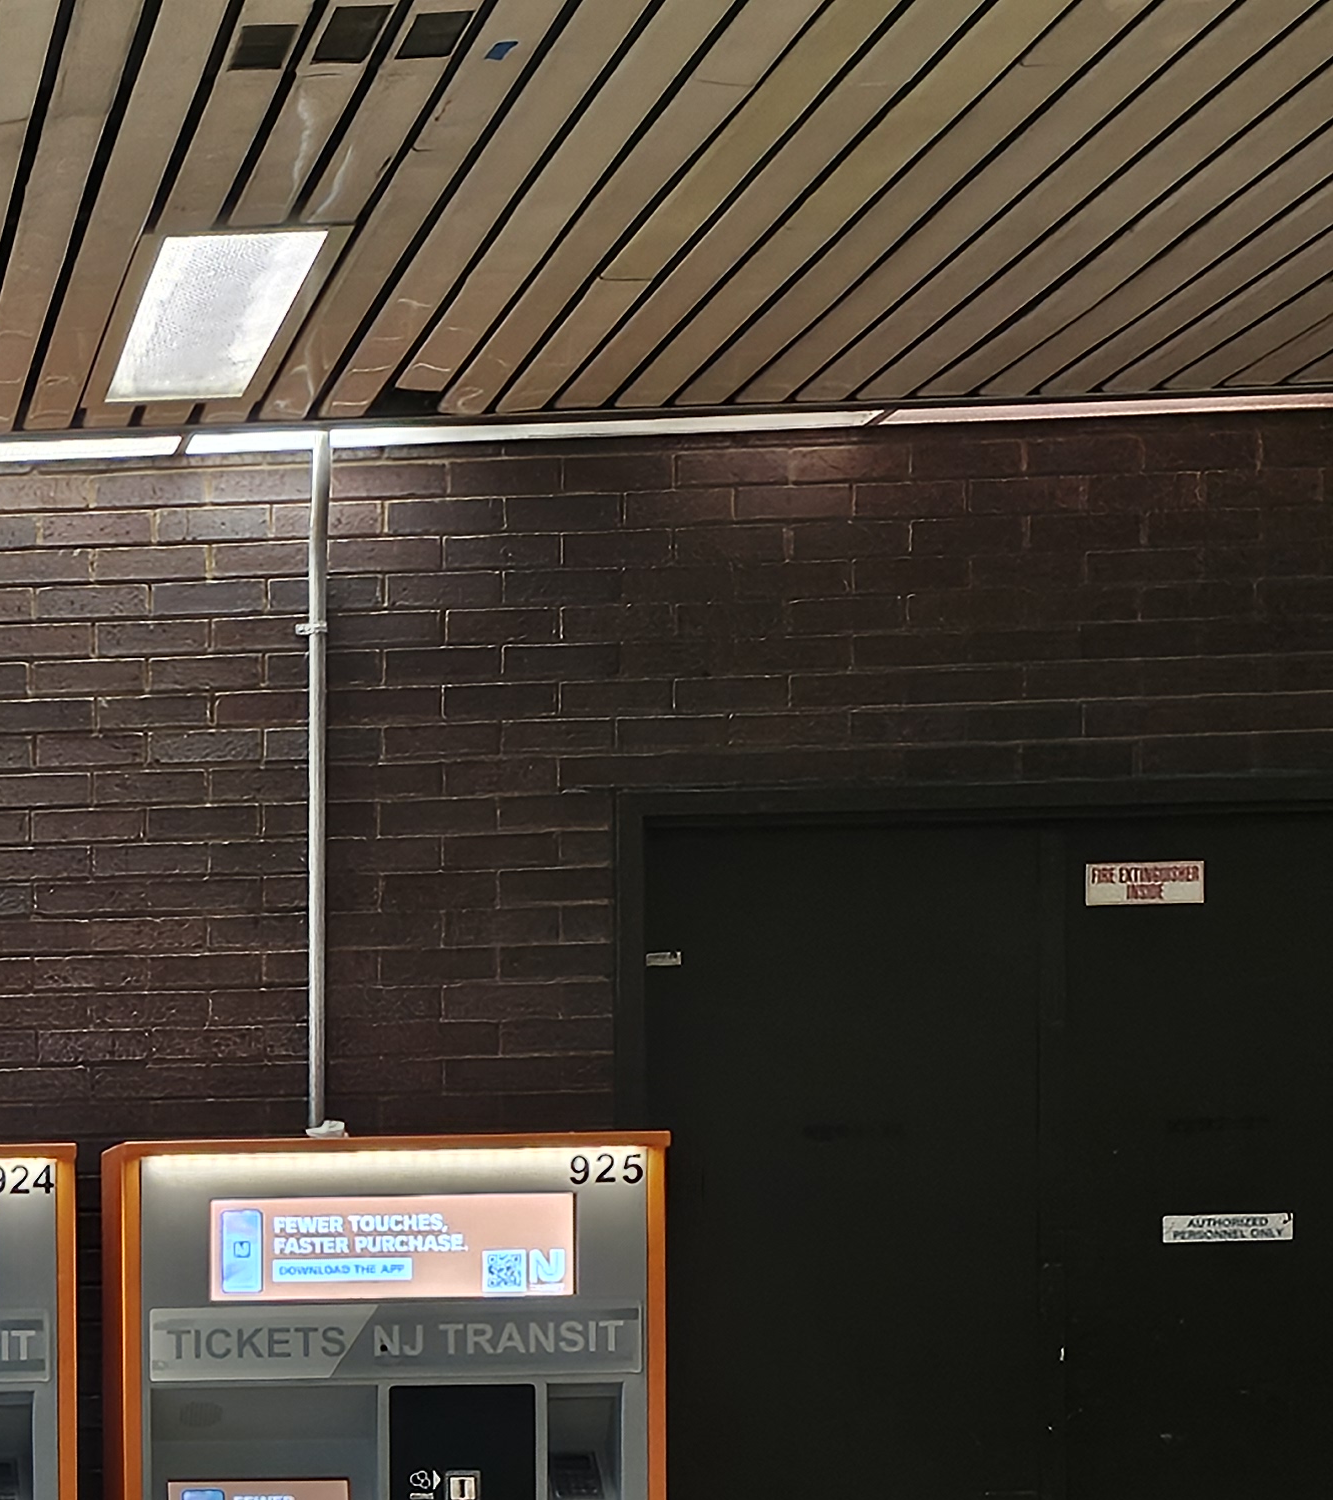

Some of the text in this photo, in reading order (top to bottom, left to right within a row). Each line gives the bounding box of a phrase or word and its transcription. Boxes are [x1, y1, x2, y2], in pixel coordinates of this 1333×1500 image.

[1092, 866, 1199, 884] FIRE EXTINGUISHER
[1127, 884, 1163, 899] INSIDE
[569, 1153, 644, 1185] 925
[273, 1214, 448, 1234] FEWER TOUCHES,
[1188, 1217, 1269, 1228] AUTHORIZED
[1173, 1228, 1283, 1240] PERSONNEL ONLY
[274, 1234, 468, 1255] FASTER PURCHASE.
[279, 1264, 405, 1275] DOWNLOAD THE APP
[167, 1326, 346, 1360] TICKETS
[373, 1320, 623, 1357] NJ TRANSIT
